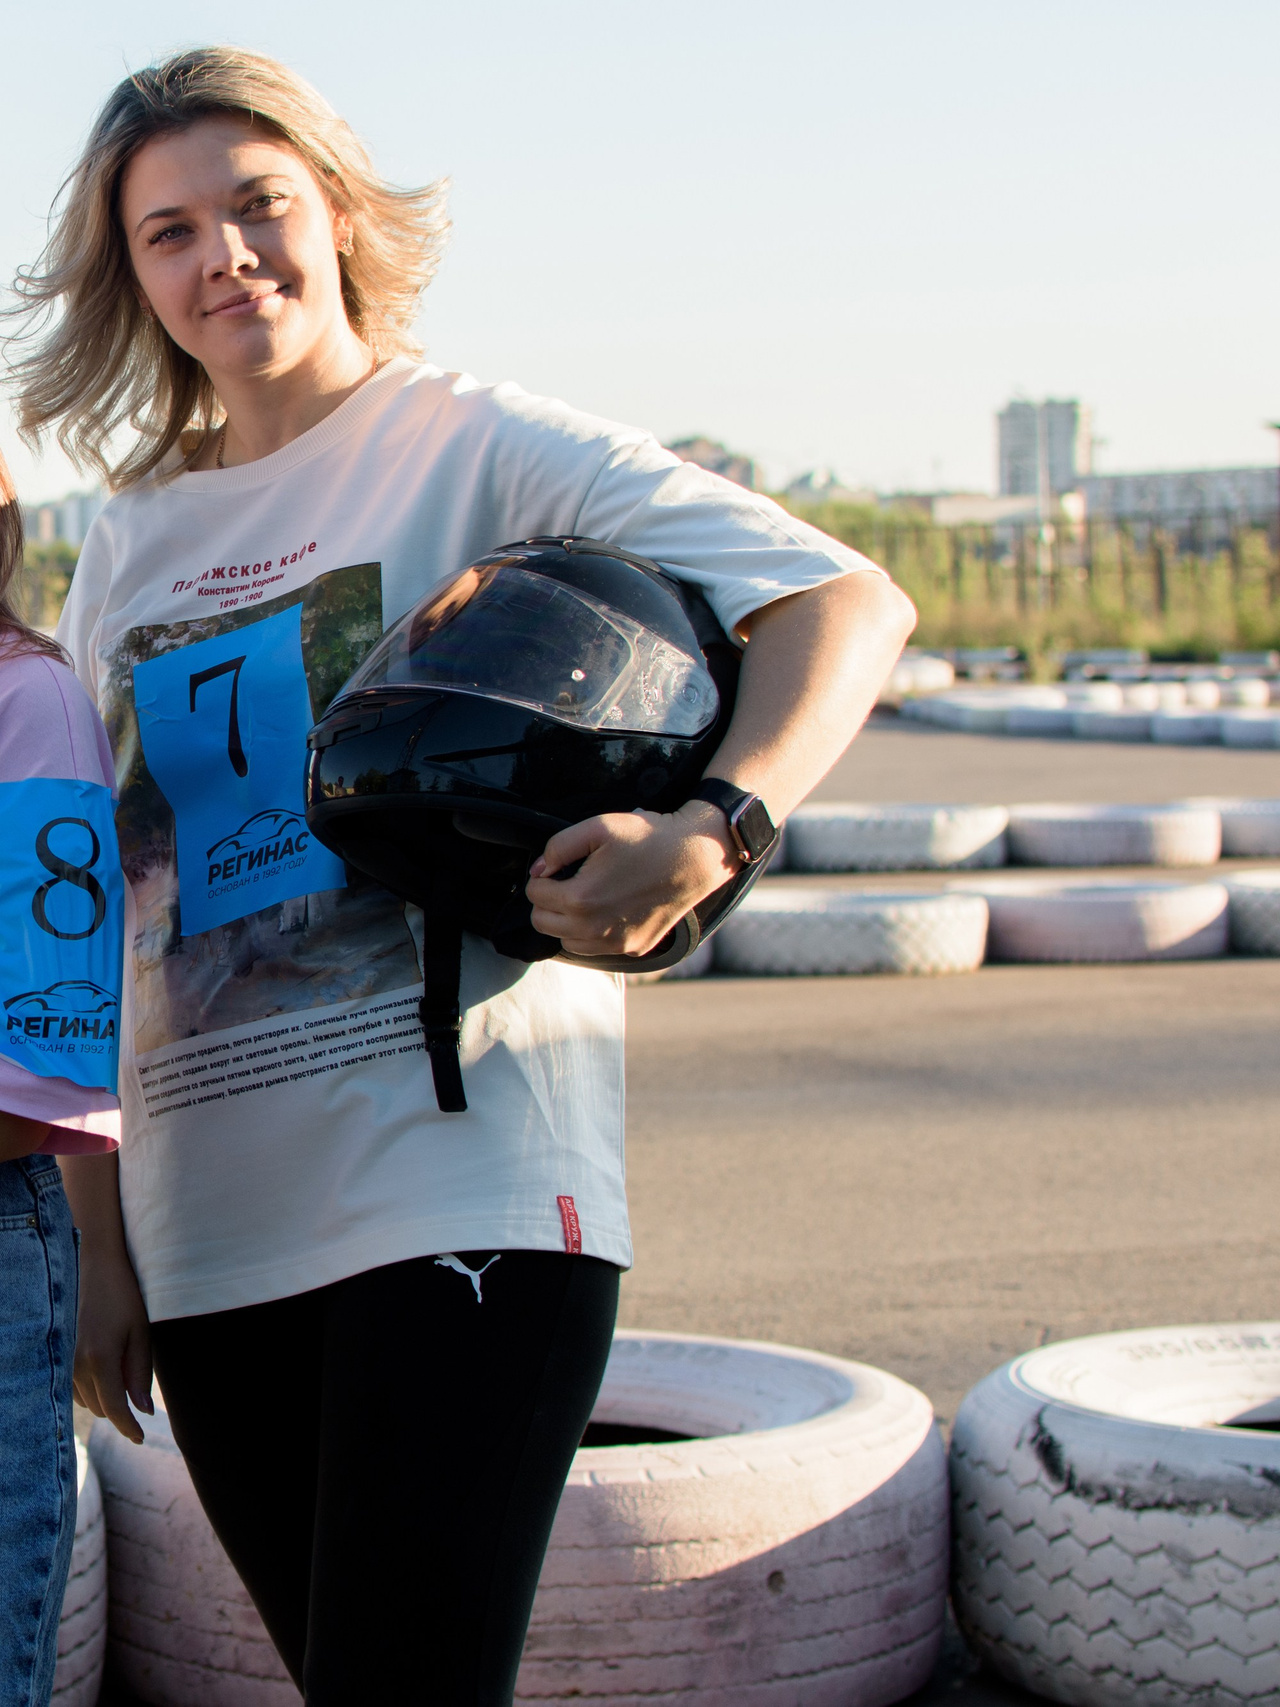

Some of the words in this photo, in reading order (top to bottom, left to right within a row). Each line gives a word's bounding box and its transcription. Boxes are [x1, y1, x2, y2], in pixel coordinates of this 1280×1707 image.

[172, 560, 272, 593] Парижское
[279, 541, 317, 568] кафе
[197, 583, 250, 597] Константин
[251, 573, 285, 588] Коровин
[219, 598, 239, 610] 1890
[189, 655, 248, 778] 7
[31, 816, 107, 940] 8
[207, 831, 310, 886] РЕГИНАС
[207, 876, 251, 899] ОСНОВАН
[253, 873, 260, 883] В
[262, 865, 281, 879] 1992
[283, 855, 308, 872] ГОДУ
[67, 1043, 76, 1053] В
[80, 1044, 105, 1054] 1992
[175, 1051, 196, 1063] контуры
[197, 1043, 232, 1058] предметов,
[232, 1036, 252, 1048] почти
[253, 1028, 289, 1044] растворяя
[291, 1025, 302, 1033] их.
[304, 1014, 347, 1029] Солнечные
[349, 1010, 368, 1019] лучи
[182, 1064, 207, 1076] создавая
[210, 1058, 230, 1069] вокруг
[232, 1056, 244, 1064] них
[245, 1046, 278, 1060] световые
[280, 1039, 311, 1052] ореолы.
[313, 1030, 346, 1043] Нежные
[349, 1020, 382, 1034] голубые
[227, 1069, 251, 1080] пятном
[252, 1061, 282, 1075] красного
[283, 1056, 307, 1066] зонта,
[309, 1049, 326, 1060] цвет
[329, 1040, 363, 1054] которого
[197, 1091, 227, 1104] зеленому.
[227, 1082, 263, 1096] Бирюзовая
[265, 1076, 288, 1088] дымка
[289, 1063, 338, 1081] пространства
[340, 1053, 376, 1067] смягчает
[378, 1048, 396, 1058] этот
[565, 1198, 574, 1215] АРТ
